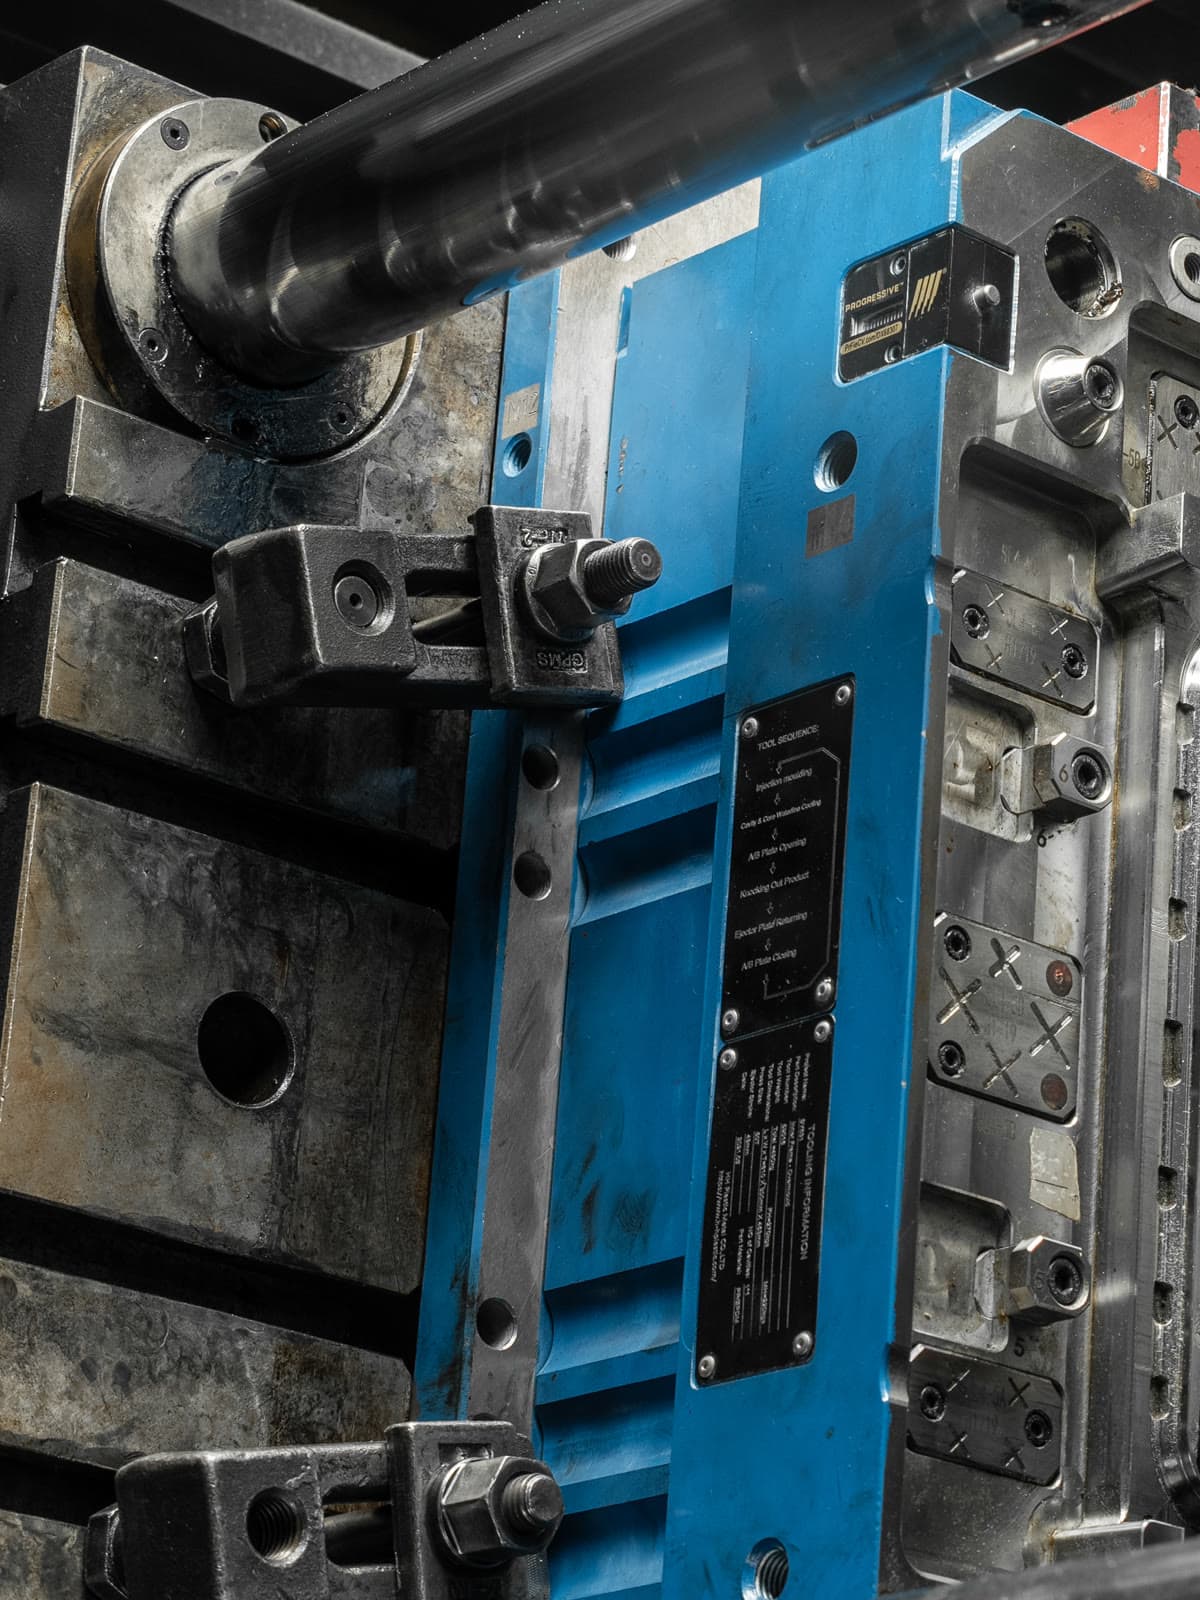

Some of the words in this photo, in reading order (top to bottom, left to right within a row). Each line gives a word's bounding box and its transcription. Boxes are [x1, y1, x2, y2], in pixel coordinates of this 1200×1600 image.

[758, 738, 775, 751] TOOL
[755, 774, 782, 793] Injection
[1059, 764, 1068, 783] 6
[761, 844, 777, 857] Plate
[778, 835, 806, 854] Opening
[739, 881, 769, 899] Knocking
[770, 878, 783, 890] Out
[784, 870, 809, 886] Product
[734, 924, 757, 939] Ejector
[754, 954, 771, 967] Plate
[772, 946, 797, 963] Closing
[804, 1124, 815, 1176] TOOLING
[721, 1186, 729, 1212] Plastic
[720, 1212, 728, 1237] Metal
[799, 1177, 812, 1260] INFORMATION
